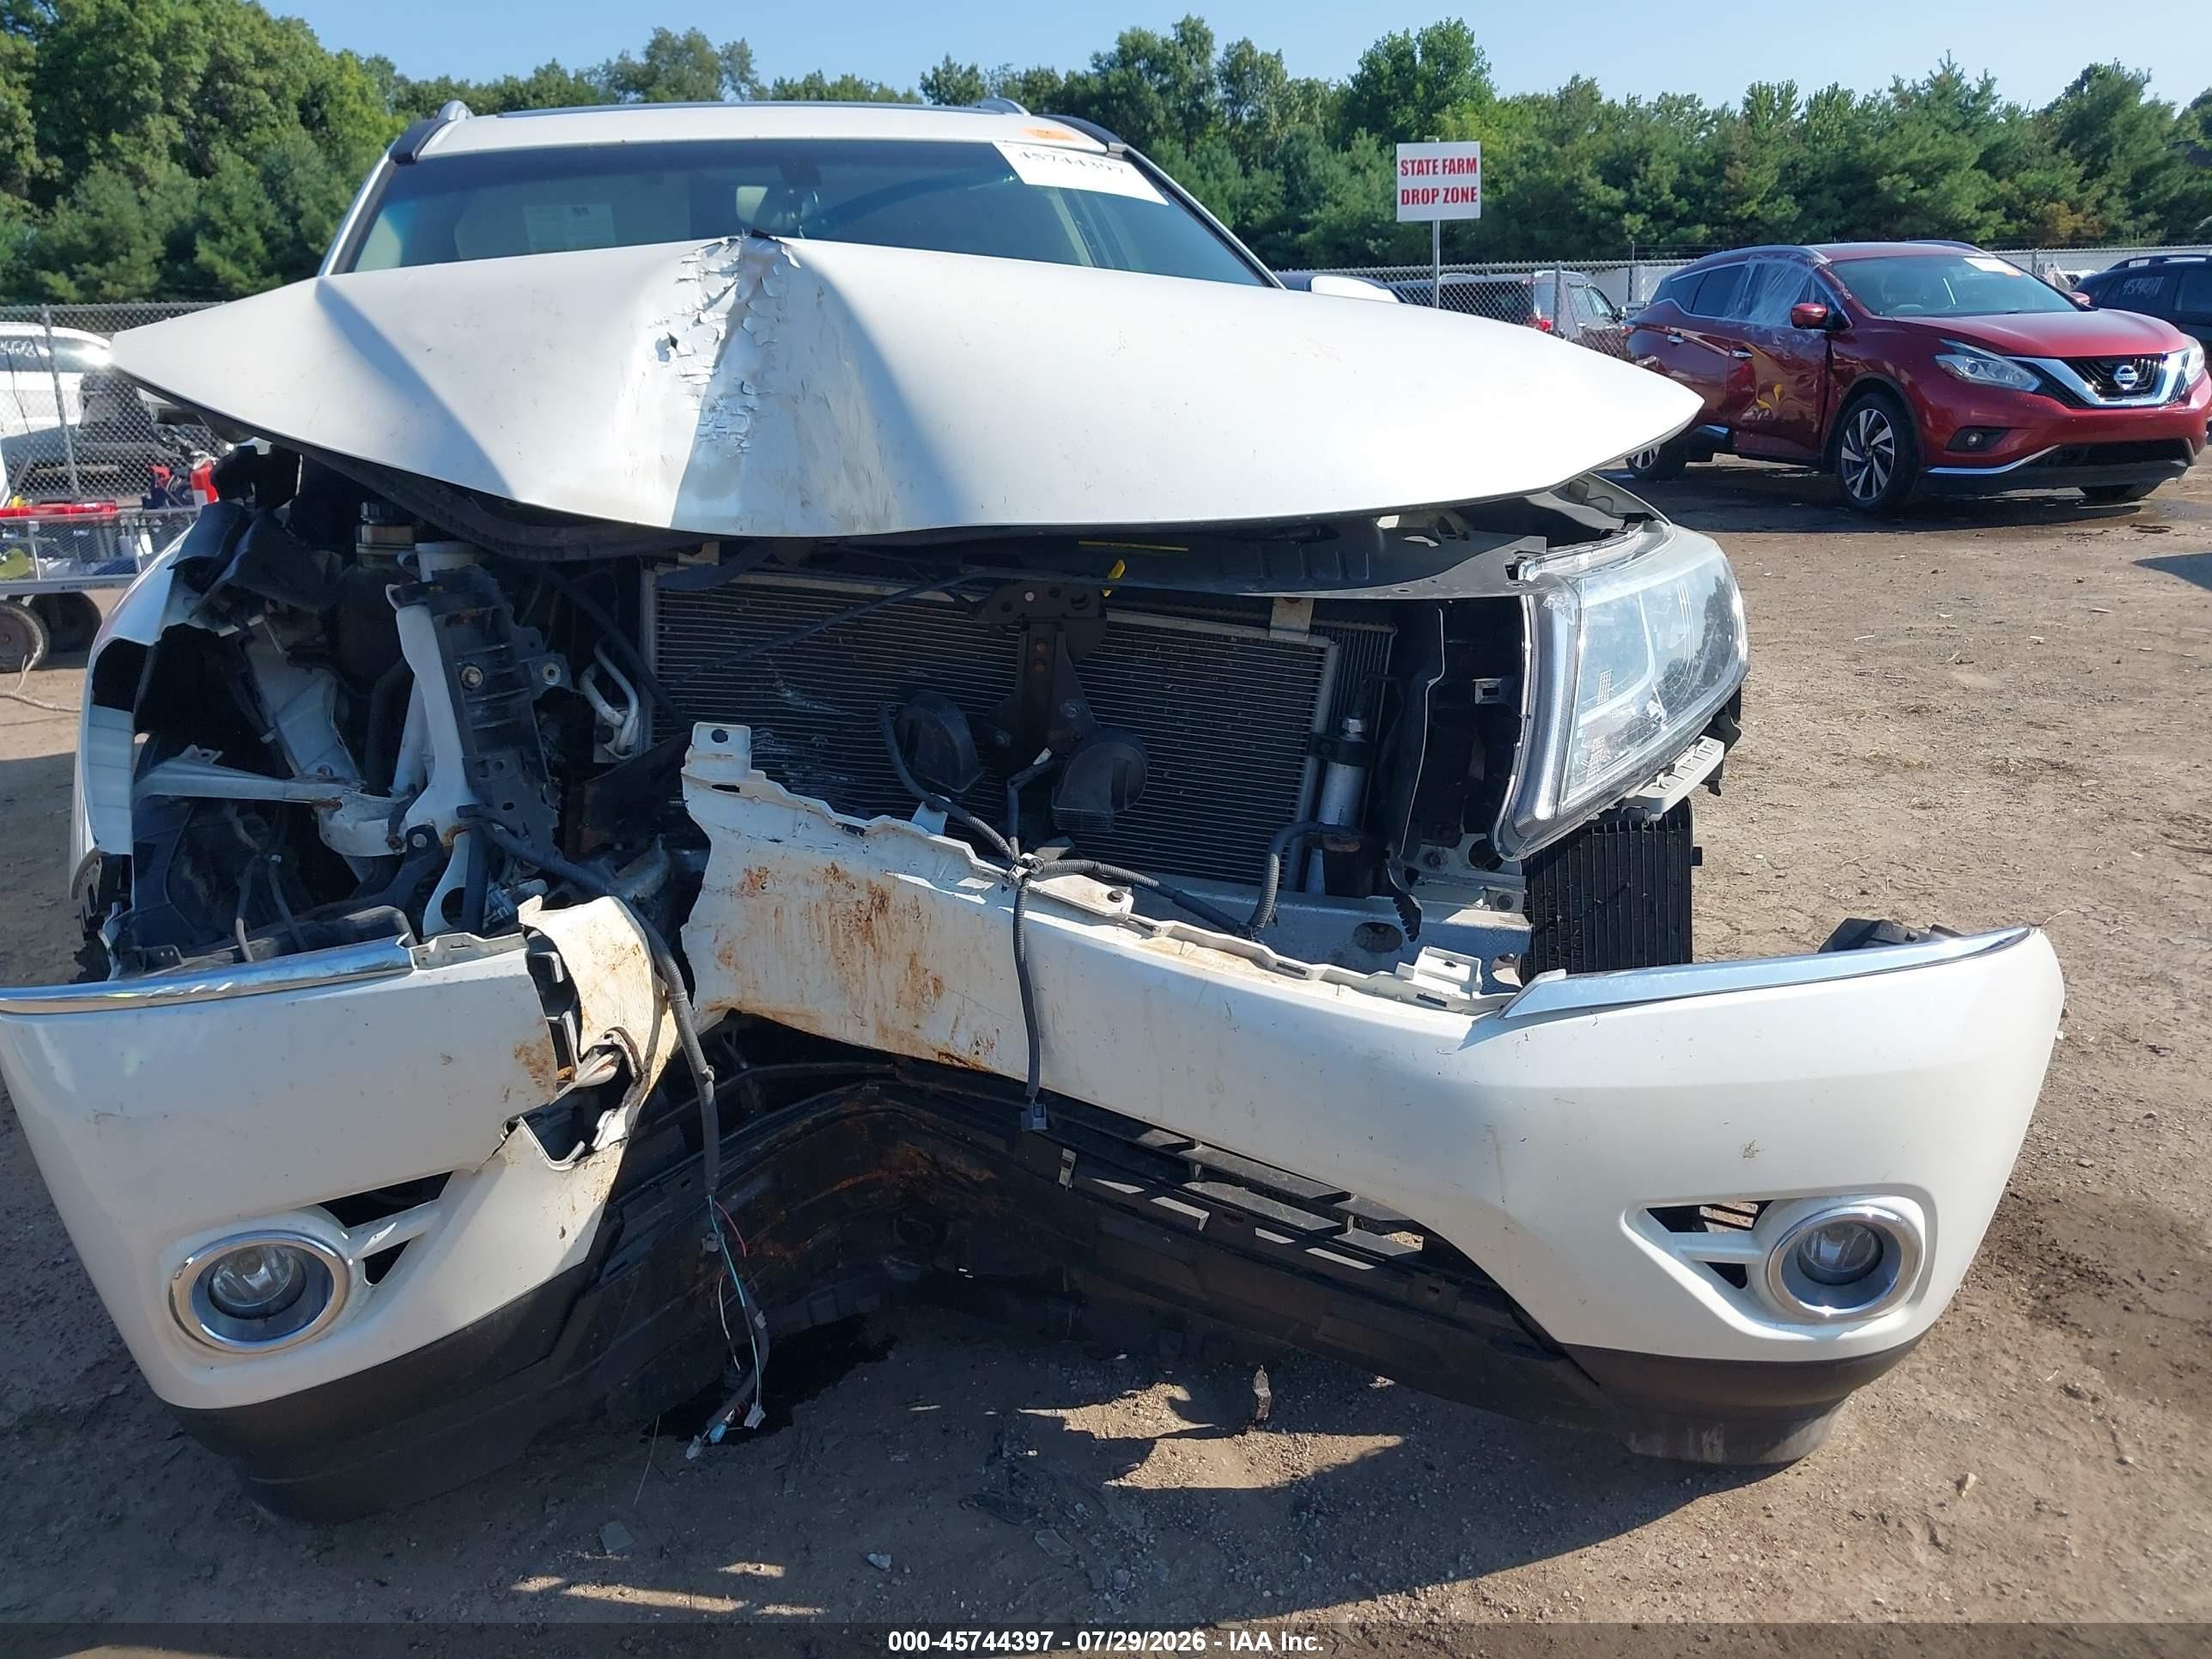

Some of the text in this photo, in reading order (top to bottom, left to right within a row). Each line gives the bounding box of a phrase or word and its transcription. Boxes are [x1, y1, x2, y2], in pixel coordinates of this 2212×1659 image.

[1401, 157, 1477, 176] STATE FARM
[1401, 186, 1478, 205] DROP ZONE
